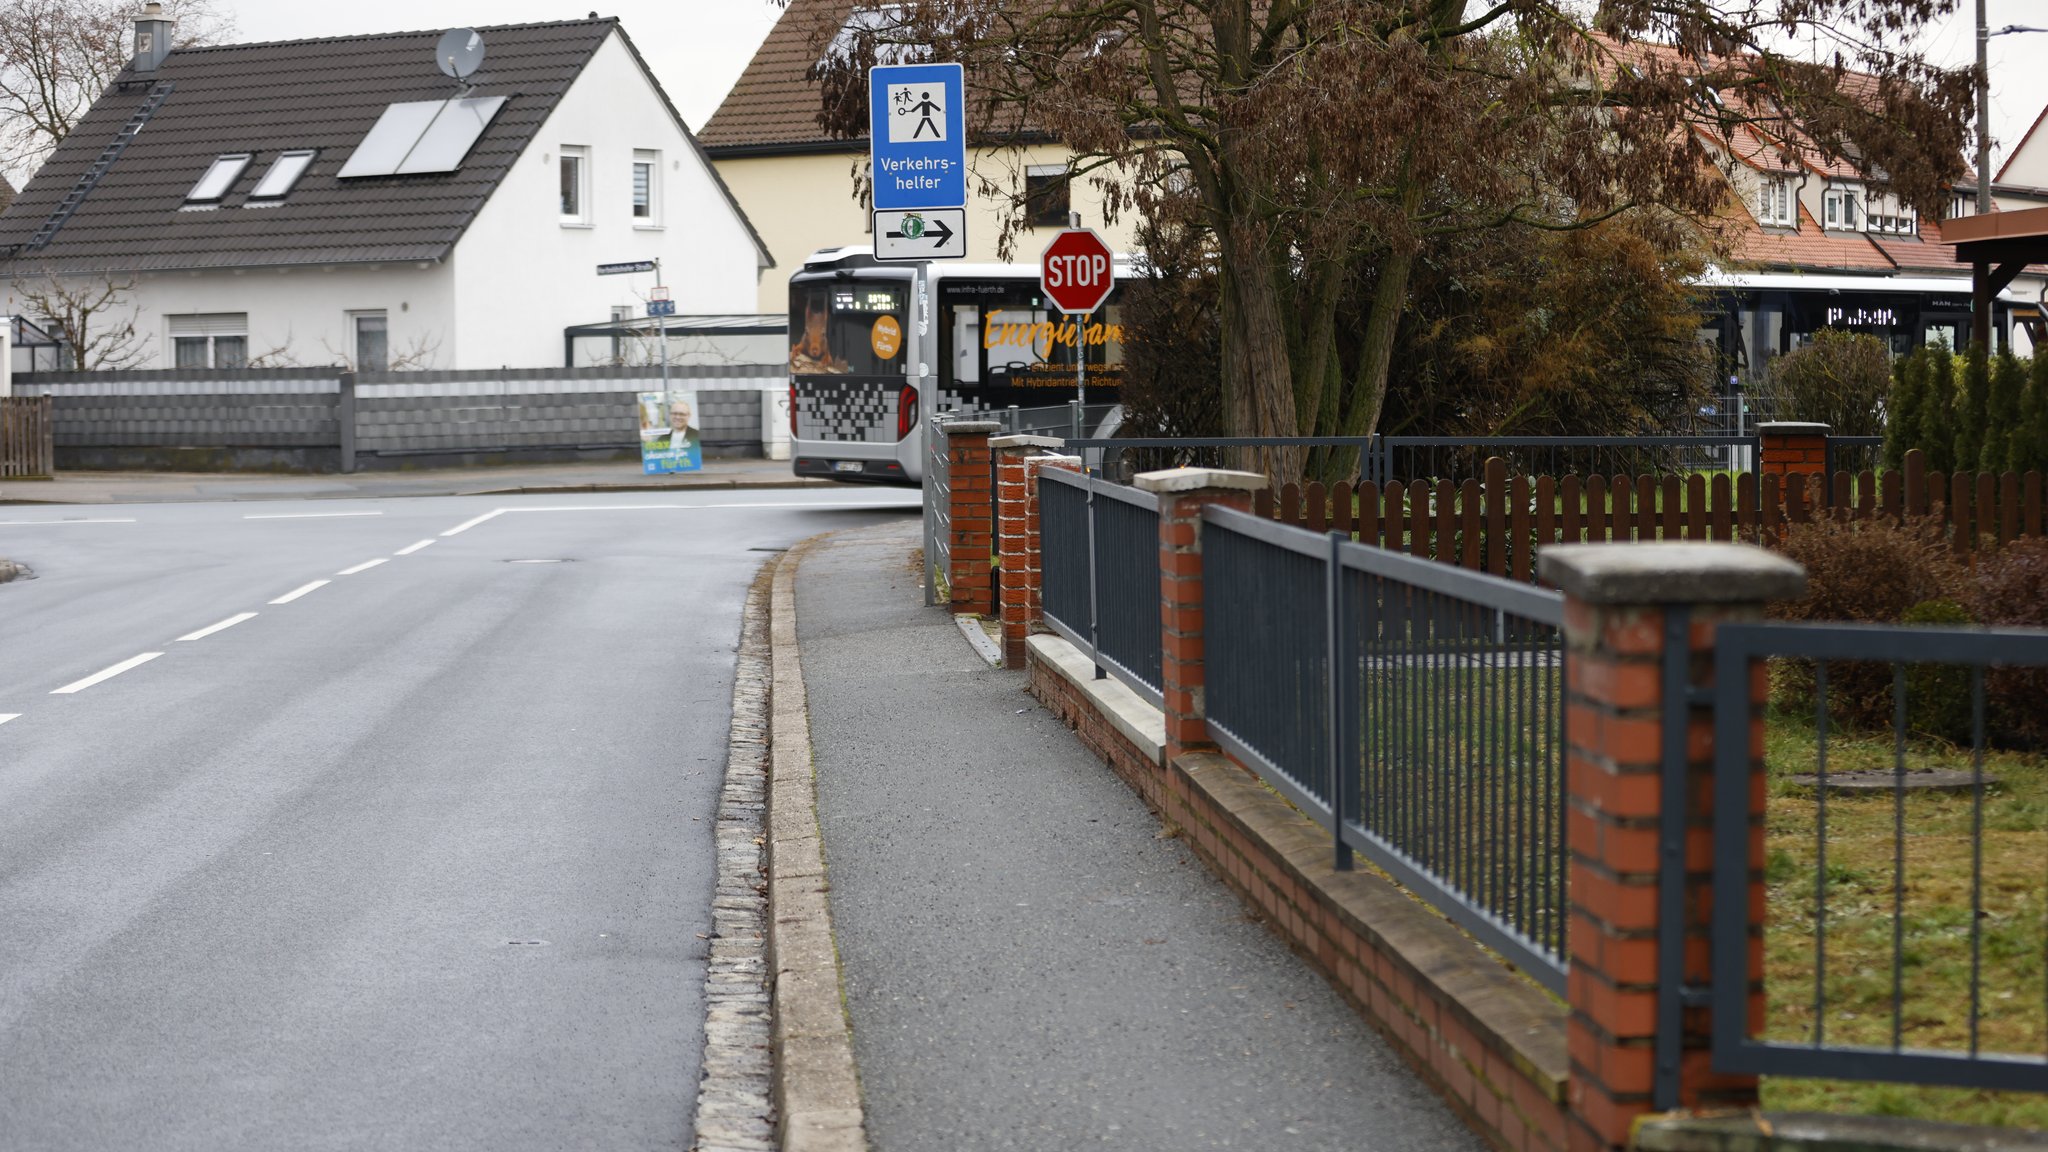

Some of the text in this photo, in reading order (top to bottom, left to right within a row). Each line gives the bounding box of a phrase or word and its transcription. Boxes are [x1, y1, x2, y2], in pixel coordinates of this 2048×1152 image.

[880, 156, 956, 172] Verkehrs-
[895, 175, 941, 190] helfer
[1047, 254, 1106, 287] STOP
[946, 285, 1005, 295] www.infra-fuerth.de
[877, 324, 897, 337] Hybrid
[1011, 376, 1025, 387] Mit
